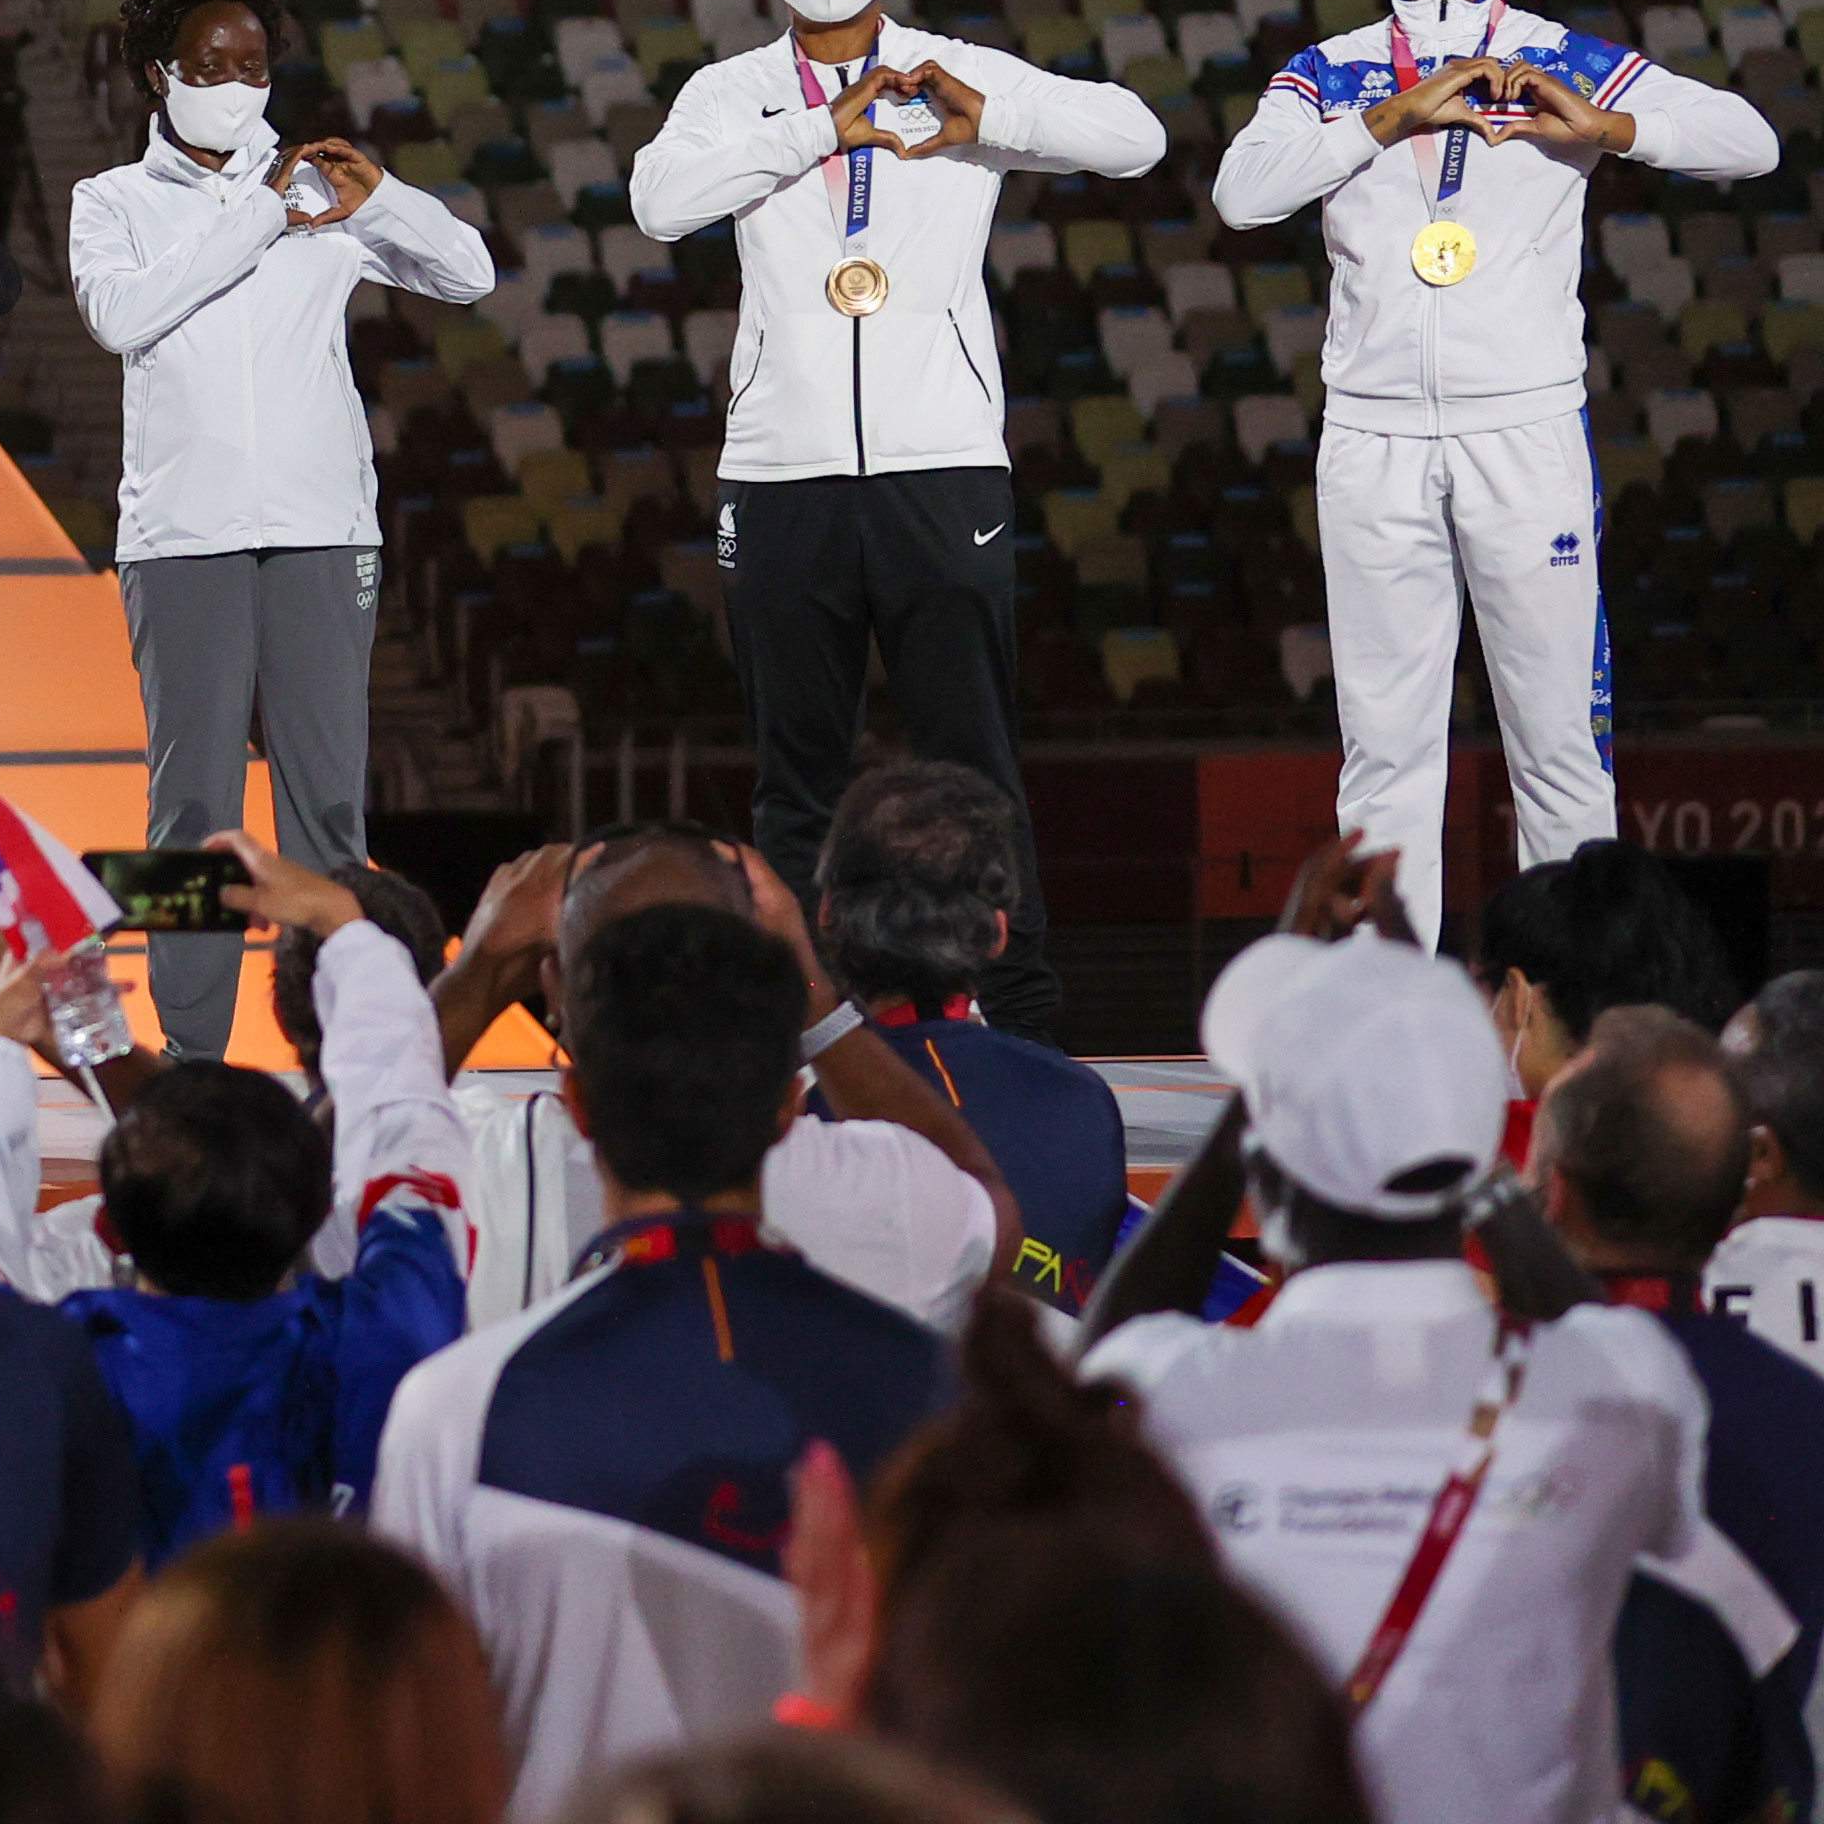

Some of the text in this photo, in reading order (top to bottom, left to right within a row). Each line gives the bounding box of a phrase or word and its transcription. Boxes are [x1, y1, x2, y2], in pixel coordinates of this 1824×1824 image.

[853, 155, 867, 220] TOKYO 2020
[1446, 145, 1462, 183] TOKYO
